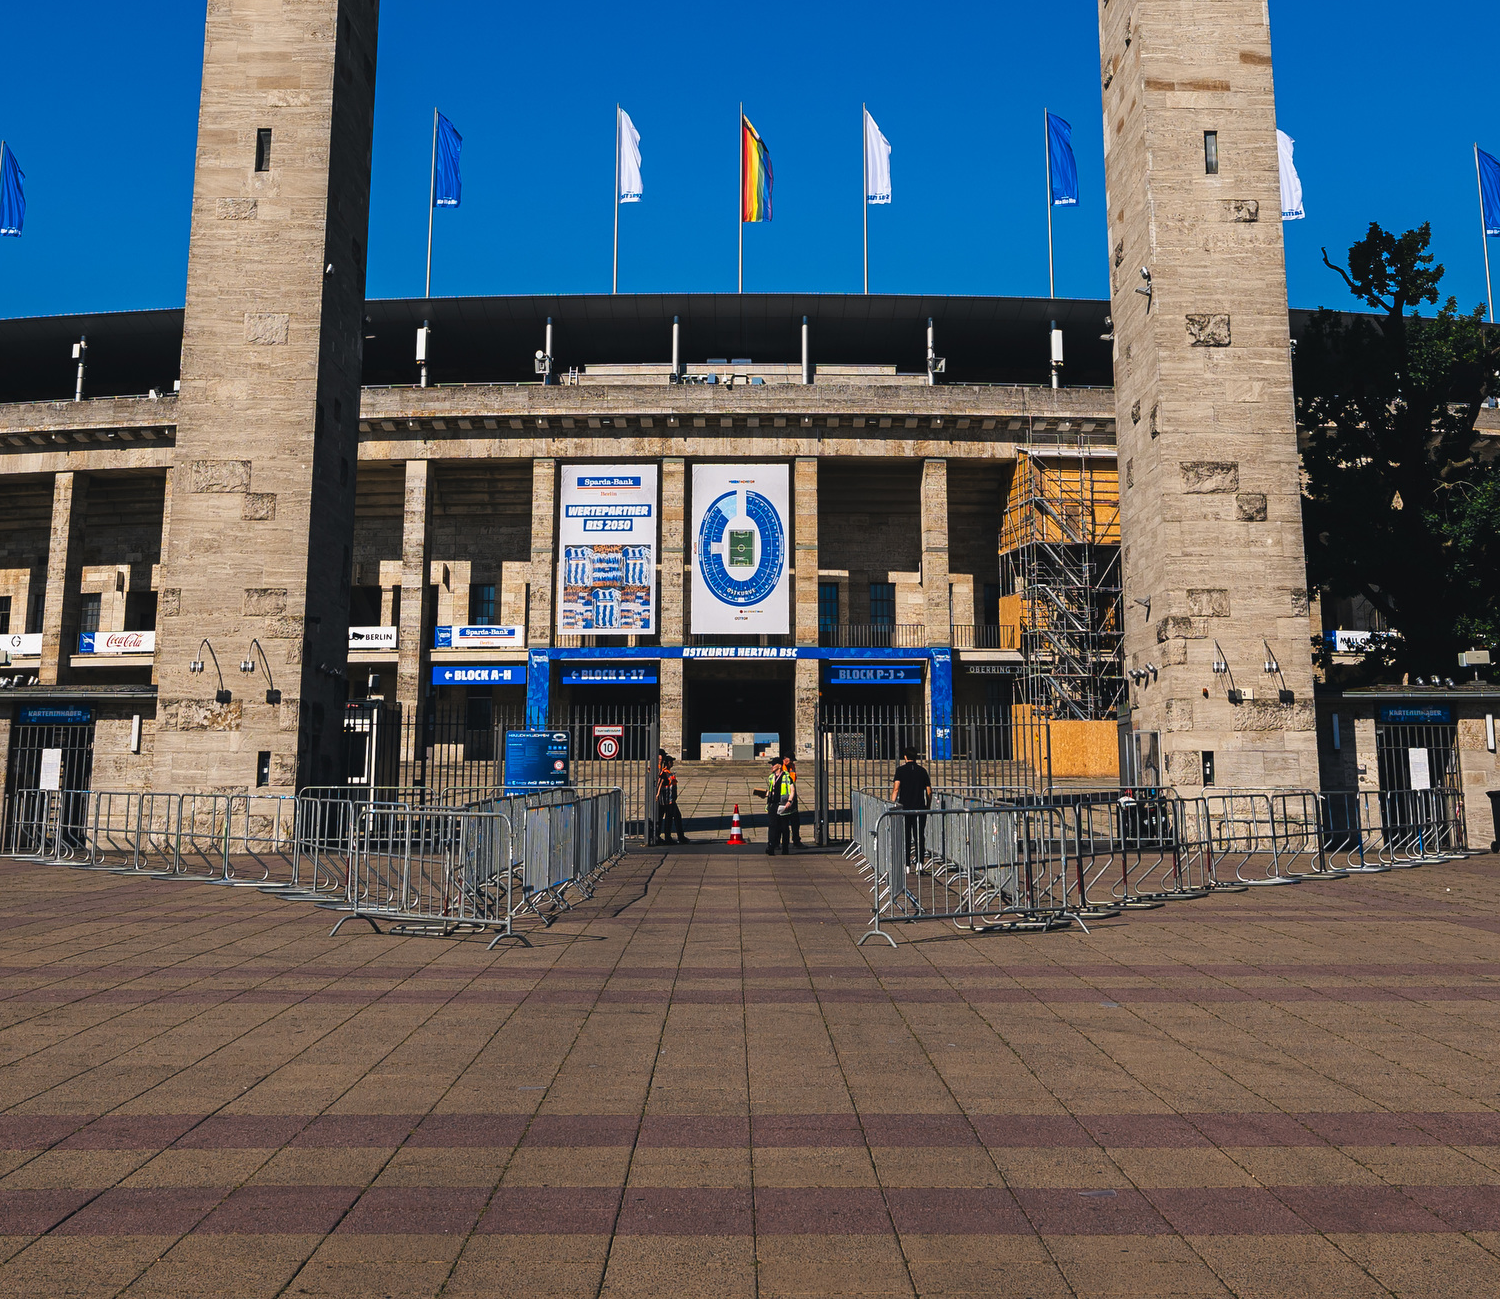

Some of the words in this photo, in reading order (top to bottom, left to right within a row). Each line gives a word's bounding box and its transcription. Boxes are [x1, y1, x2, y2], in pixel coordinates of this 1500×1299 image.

[584, 478, 634, 486] Sparda-Bank
[568, 506, 648, 516] WERTEPARTNER
[585, 520, 604, 530] BIS
[604, 519, 632, 530] 2030
[726, 587, 756, 596] OSTKURVE
[465, 628, 508, 636] Sparda-Bank
[683, 648, 733, 657] OSTKURVE
[737, 648, 778, 656] HERTHA
[780, 647, 798, 656] BSC
[454, 670, 489, 680] BLOCK
[490, 670, 512, 680] A-H
[582, 670, 616, 680] BLOCK
[619, 670, 645, 680] 1-17
[839, 670, 874, 680] BLOCK
[876, 670, 894, 680] P-J
[604, 743, 612, 752] 10
